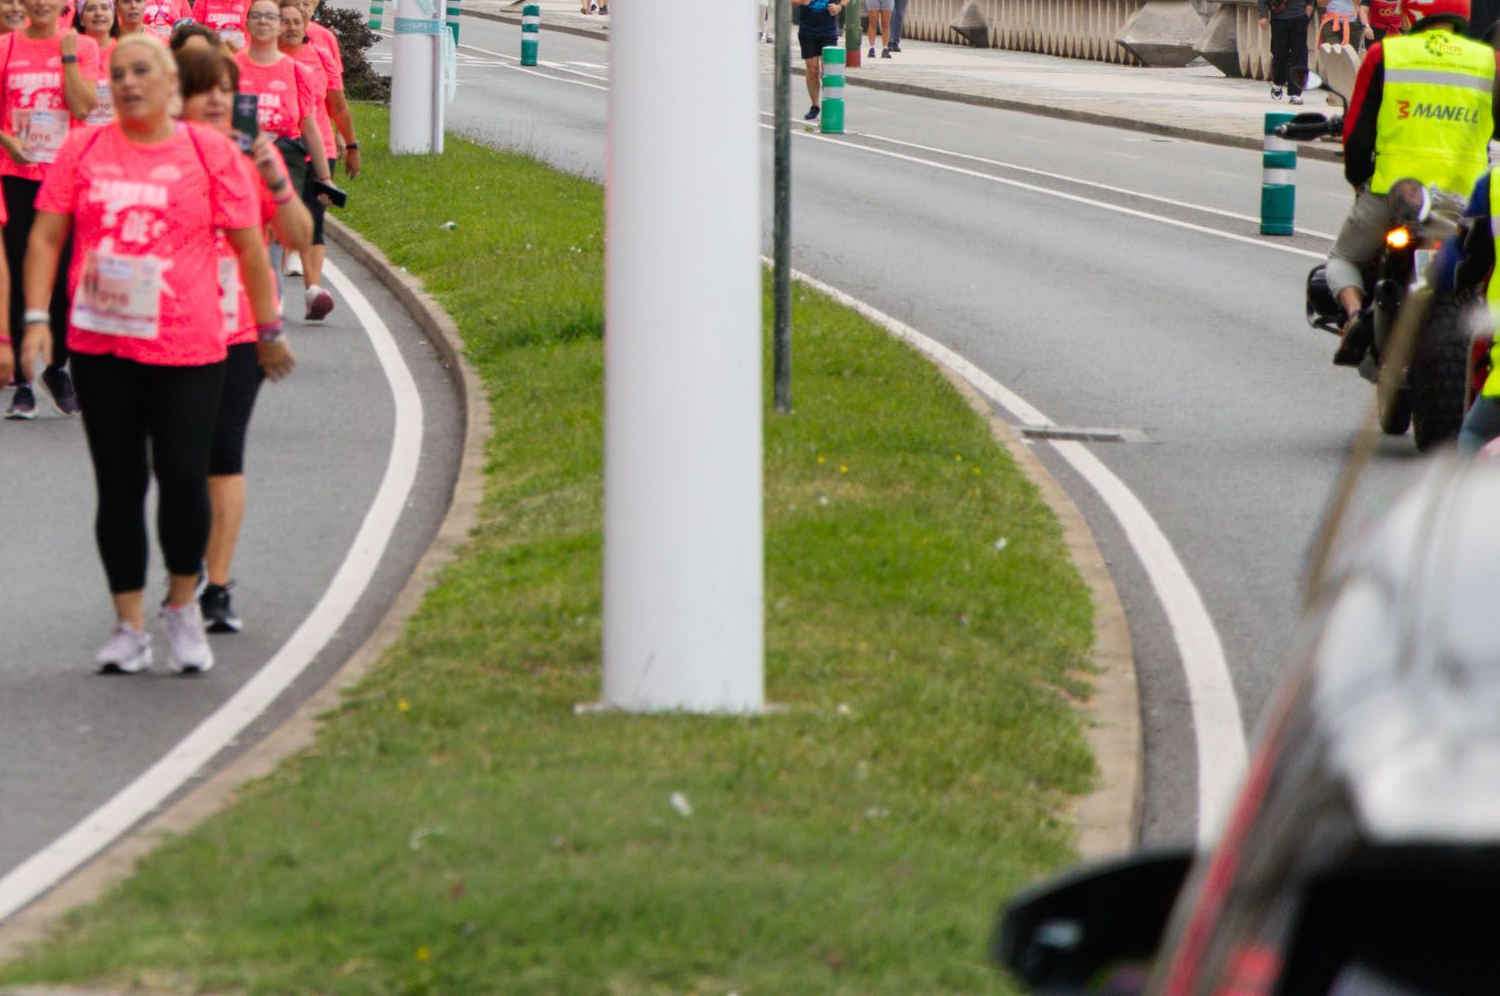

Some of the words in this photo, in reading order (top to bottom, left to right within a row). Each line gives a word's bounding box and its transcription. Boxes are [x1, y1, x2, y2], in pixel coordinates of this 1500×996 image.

[208, 13, 241, 23] CARRERA
[8, 72, 60, 89] CARRERA
[1412, 102, 1479, 124] MANELL
